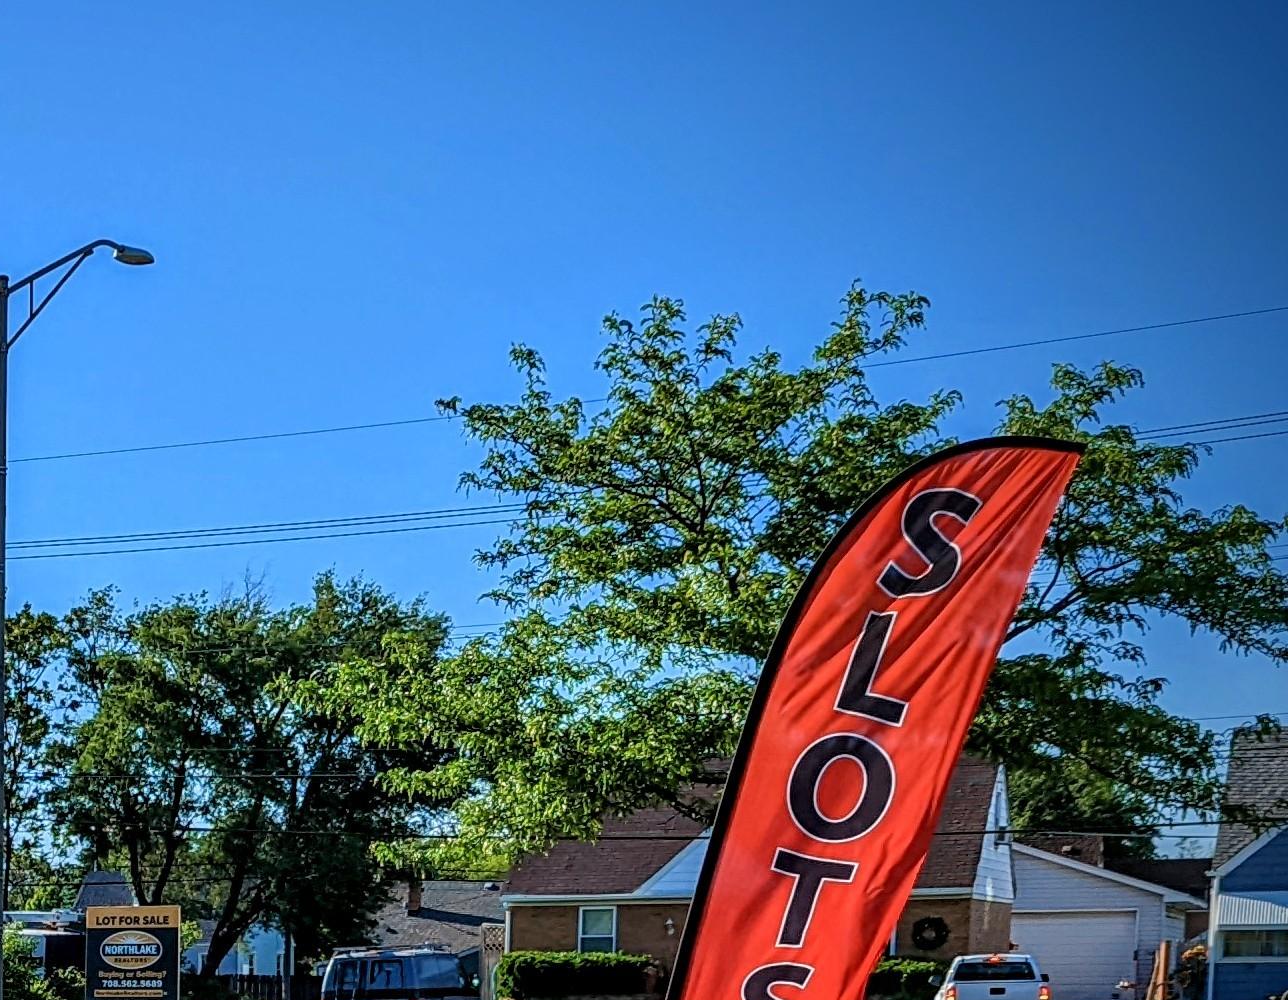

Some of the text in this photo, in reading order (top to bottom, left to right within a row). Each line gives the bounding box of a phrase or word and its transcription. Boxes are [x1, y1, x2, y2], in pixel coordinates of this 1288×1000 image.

[95, 916, 170, 926] LOT FOR SALE
[104, 945, 158, 955] NORTHLAKE
[98, 970, 125, 979] Buying
[135, 970, 167, 979] Selling?
